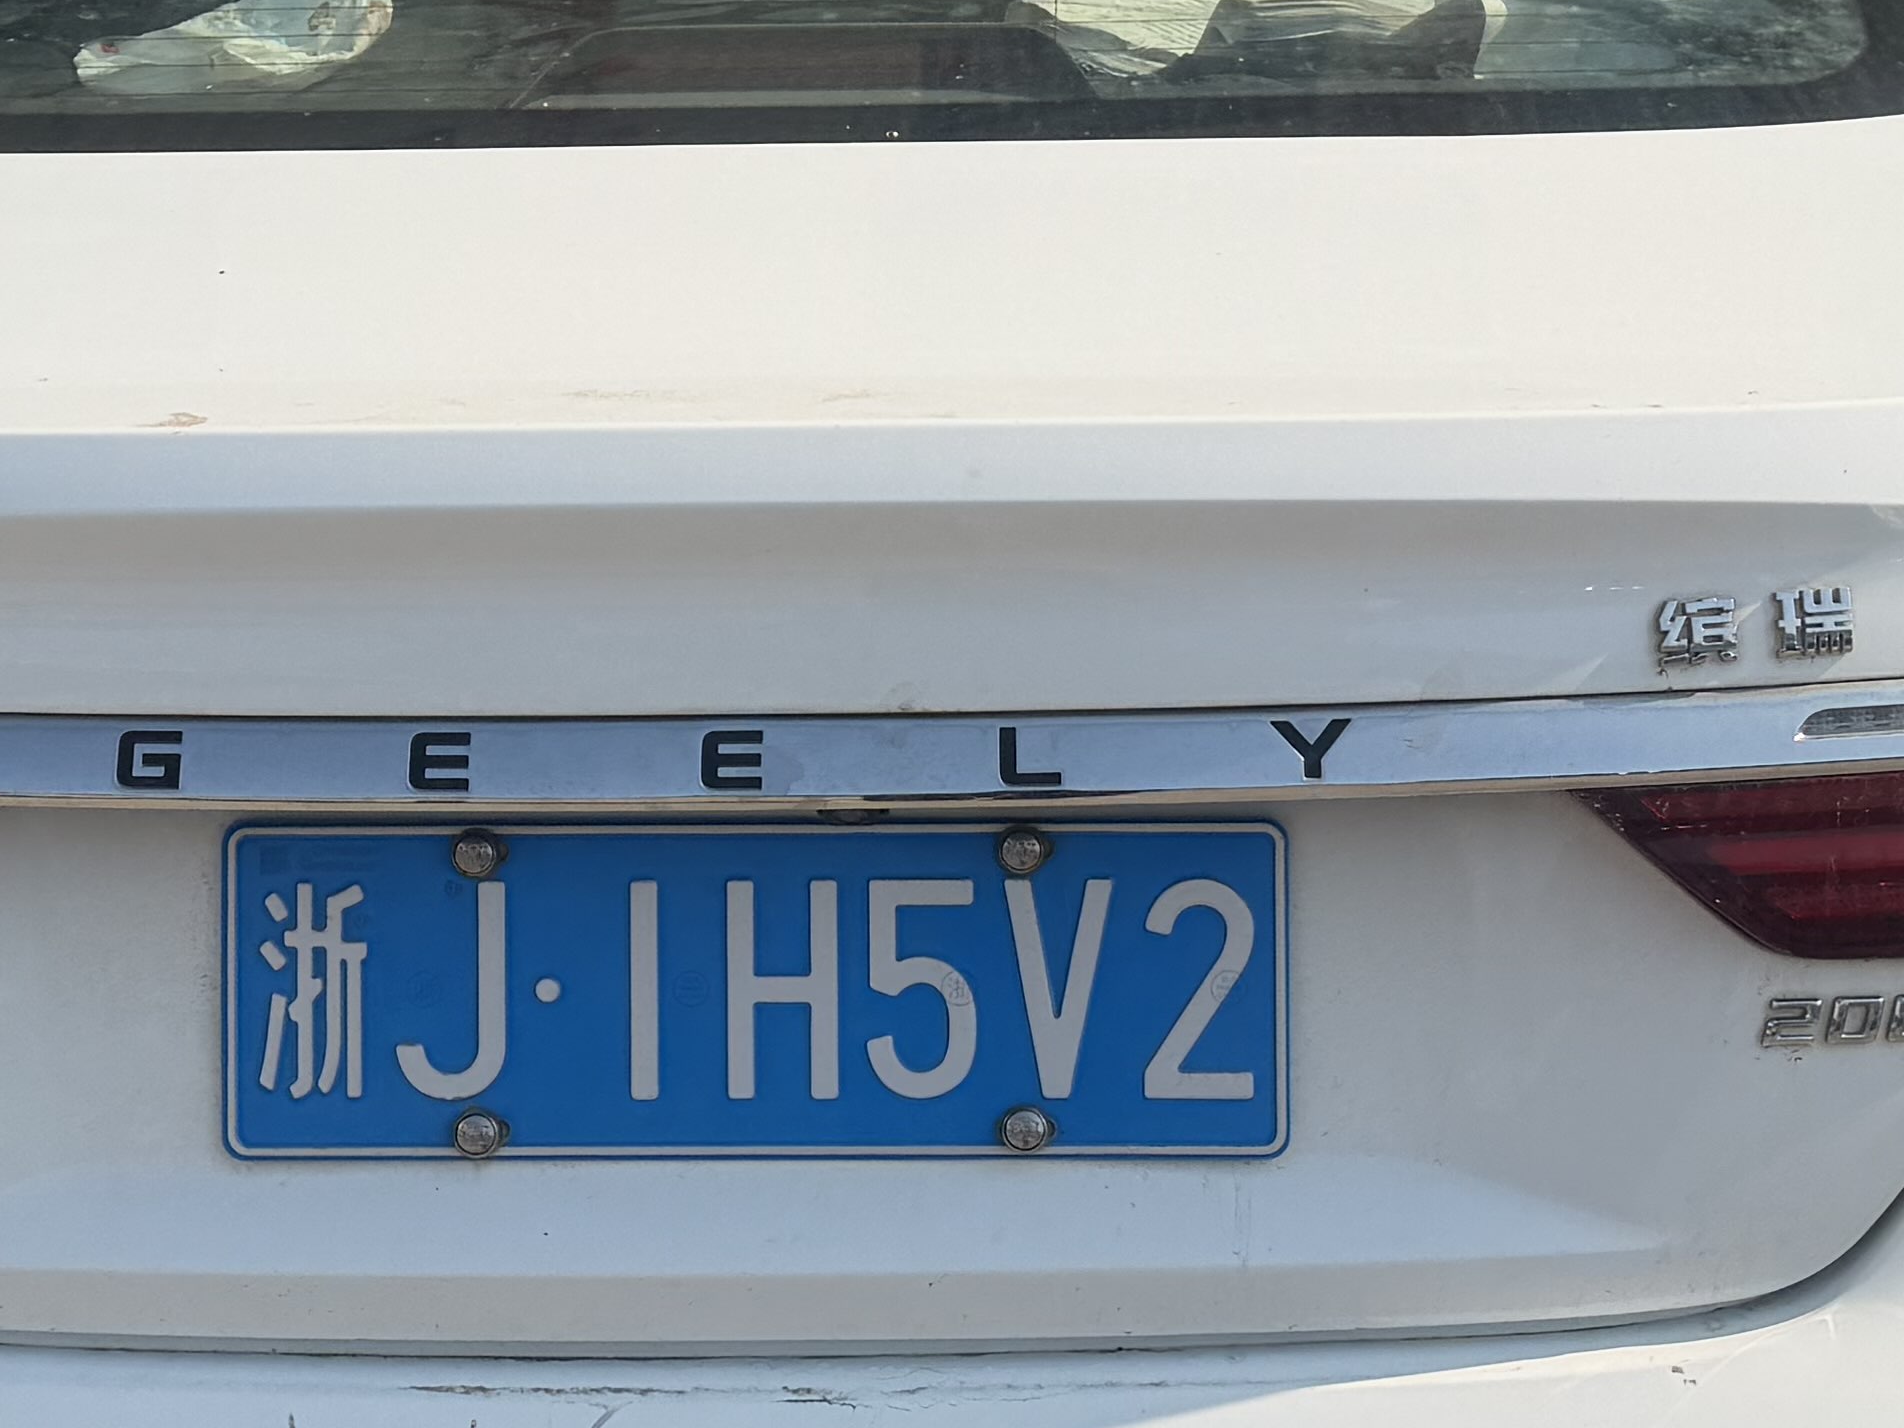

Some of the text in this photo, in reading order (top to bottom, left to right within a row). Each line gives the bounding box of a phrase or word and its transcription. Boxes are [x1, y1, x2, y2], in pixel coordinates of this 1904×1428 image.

[1656, 587, 1854, 663] 缤瑞
[115, 718, 1351, 794] GEELY
[258, 876, 1257, 1103] 浙J·1H5V2
